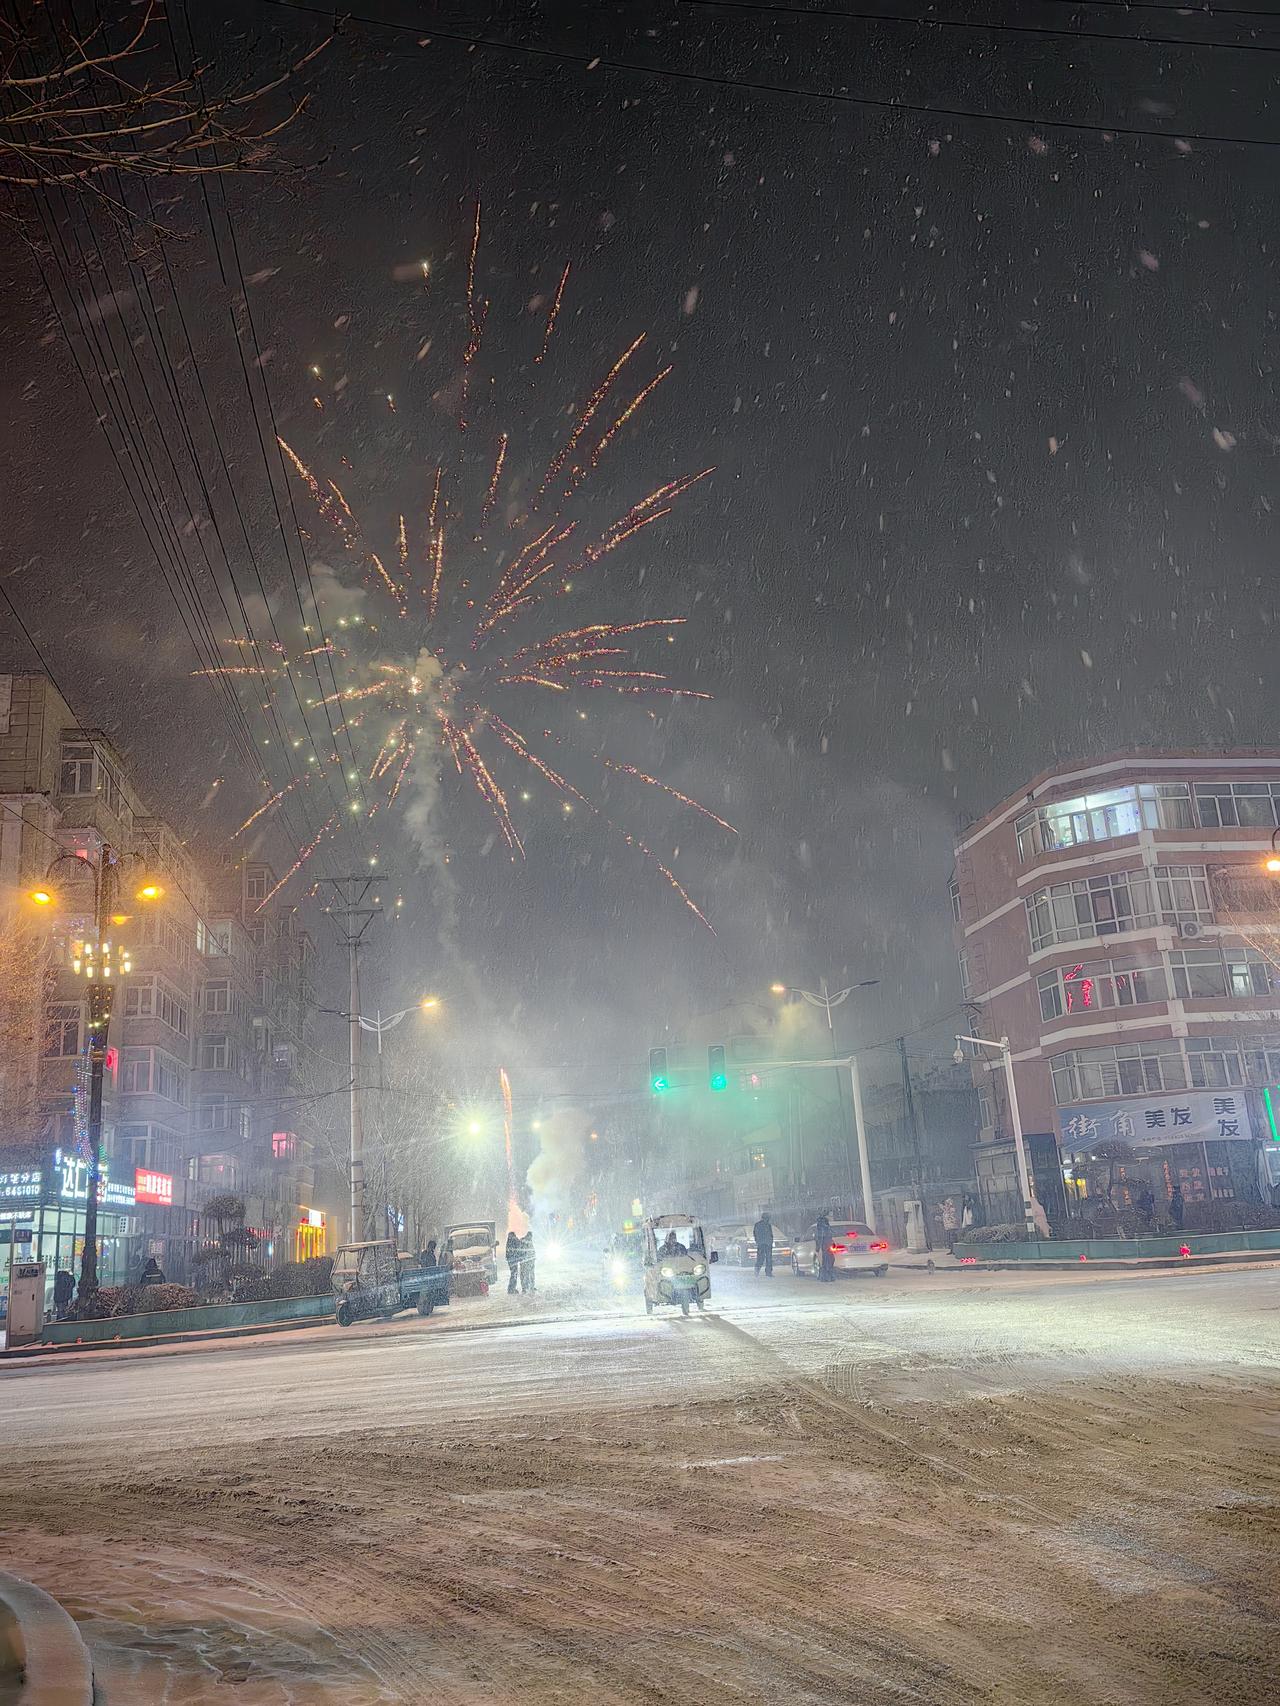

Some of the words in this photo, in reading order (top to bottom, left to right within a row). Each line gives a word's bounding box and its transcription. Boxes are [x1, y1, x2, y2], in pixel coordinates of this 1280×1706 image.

[1067, 1107, 1193, 1139] 街角美发
[1213, 1097, 1241, 1137] 美发
